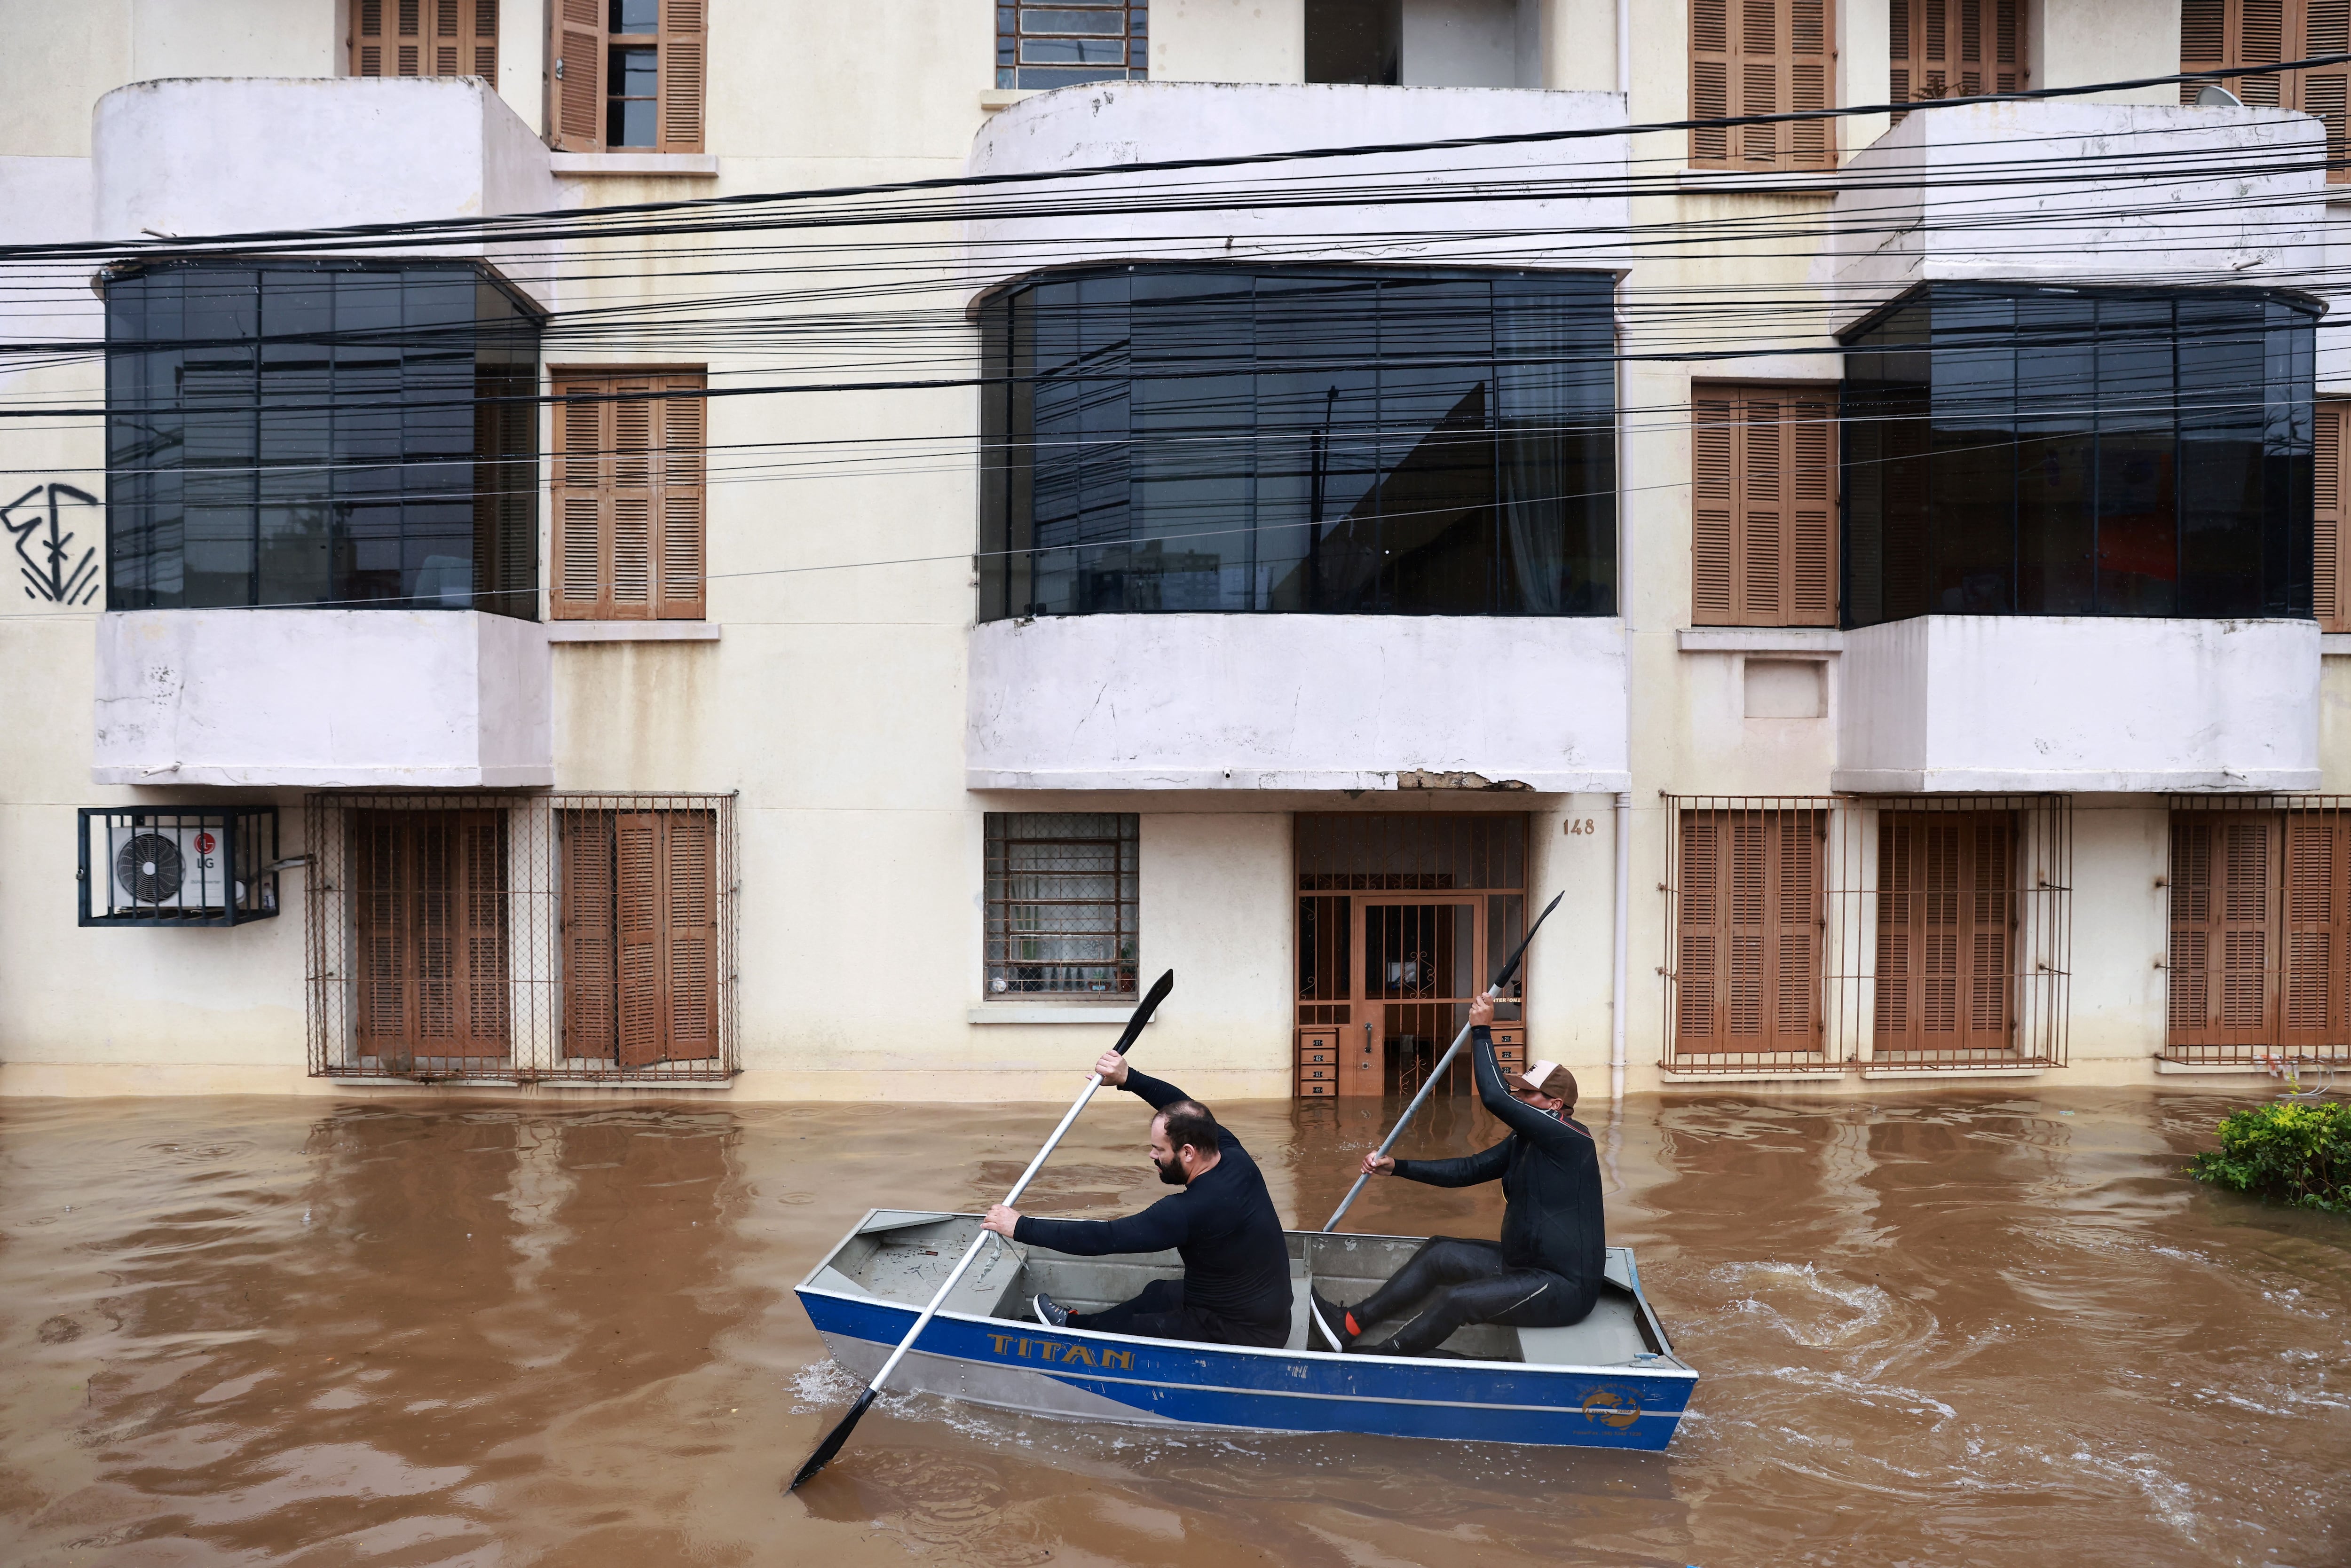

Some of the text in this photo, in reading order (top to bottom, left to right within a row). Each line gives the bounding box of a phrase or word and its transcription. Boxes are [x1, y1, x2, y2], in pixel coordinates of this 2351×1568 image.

[1563, 819, 1595, 835] 148
[197, 858, 214, 869] LG
[987, 1333, 1136, 1371] TITAN
